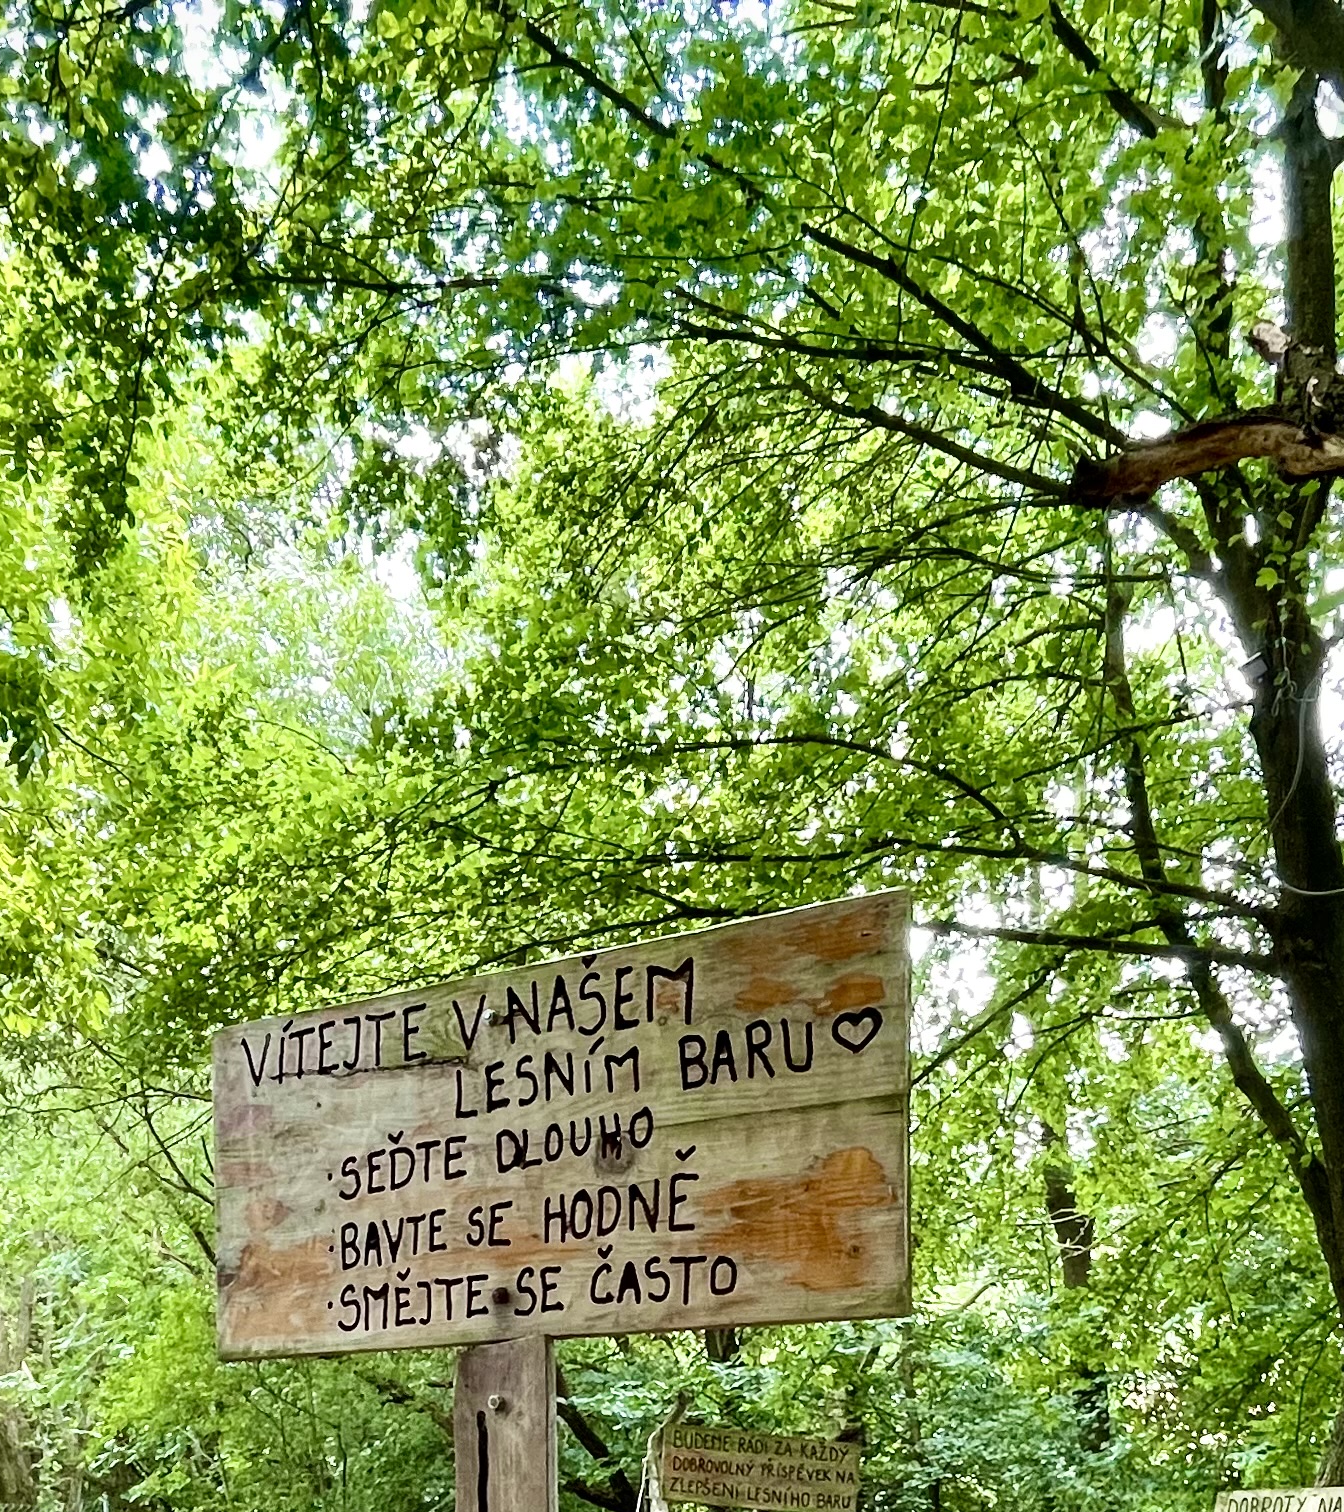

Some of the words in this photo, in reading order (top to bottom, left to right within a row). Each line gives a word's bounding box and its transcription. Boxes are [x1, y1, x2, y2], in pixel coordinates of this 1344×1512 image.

[240, 1002, 427, 1087] VÍTEJTE
[452, 994, 487, 1051] V
[506, 955, 695, 1044] NAŠEM
[454, 1037, 641, 1119] LESNÍM
[677, 1017, 815, 1091] BARU
[337, 1131, 467, 1201] SEĎTE
[496, 1106, 654, 1170] DLOUHO
[339, 1207, 448, 1271] BAVTE
[466, 1200, 513, 1248] SE
[543, 1145, 700, 1245] HODNĚ
[337, 1269, 490, 1333] SMĚJTE
[513, 1266, 565, 1318] SE
[591, 1244, 739, 1306] ČASTO
[672, 1429, 732, 1453] BUDEME
[737, 1435, 769, 1455] RÁDI
[774, 1440, 793, 1457] ZA
[800, 1439, 850, 1465] KAŽDÝ
[672, 1455, 755, 1477] DOBROVOLNÝ
[760, 1457, 832, 1482] PŘÍSPĚVEK
[836, 1470, 856, 1485] NA
[747, 1485, 811, 1508] LESNÍHO
[816, 1493, 851, 1510] BARU
